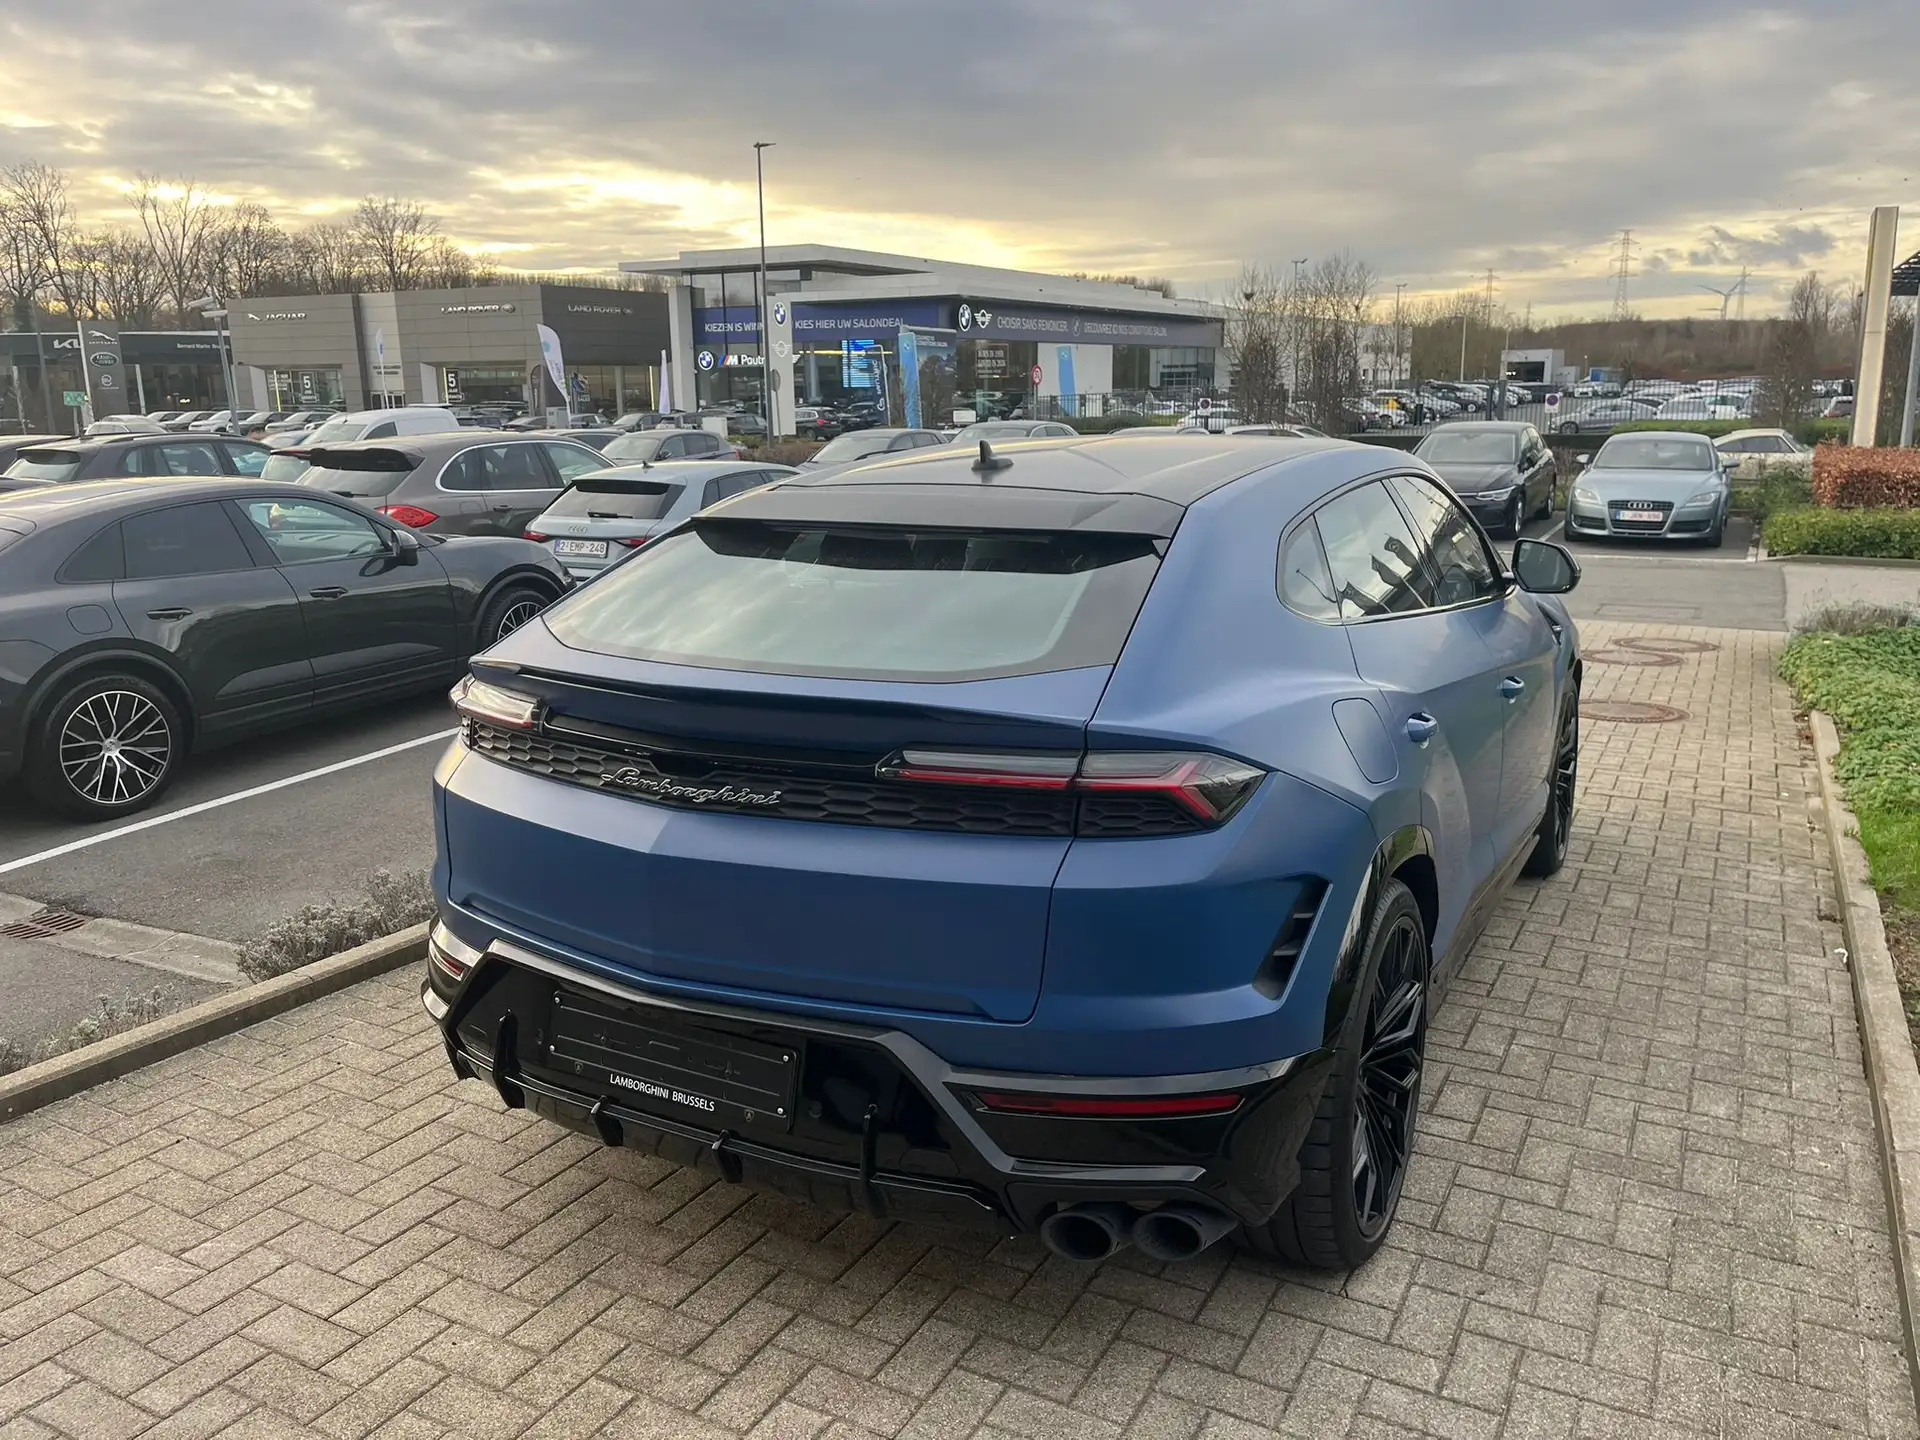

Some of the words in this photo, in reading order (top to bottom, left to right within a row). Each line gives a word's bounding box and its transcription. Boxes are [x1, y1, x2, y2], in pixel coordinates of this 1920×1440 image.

[440, 306, 466, 314] LAND
[467, 305, 499, 313] ROVER
[568, 304, 592, 312] LAND
[593, 306, 622, 314] ROVER
[266, 312, 306, 321] JAGUAR
[704, 322, 733, 332] KIEZEN
[734, 322, 742, 332] IS
[795, 320, 814, 330] KIES
[815, 320, 836, 329] HIER
[837, 319, 852, 328] UW
[1022, 318, 1037, 330] SANS
[303, 376, 310, 388] 5
[448, 374, 456, 388] 5
[600, 766, 782, 805] Lamborghini
[610, 1073, 670, 1099] LAMBORGHINI
[672, 1090, 715, 1112] BRUSSELS
